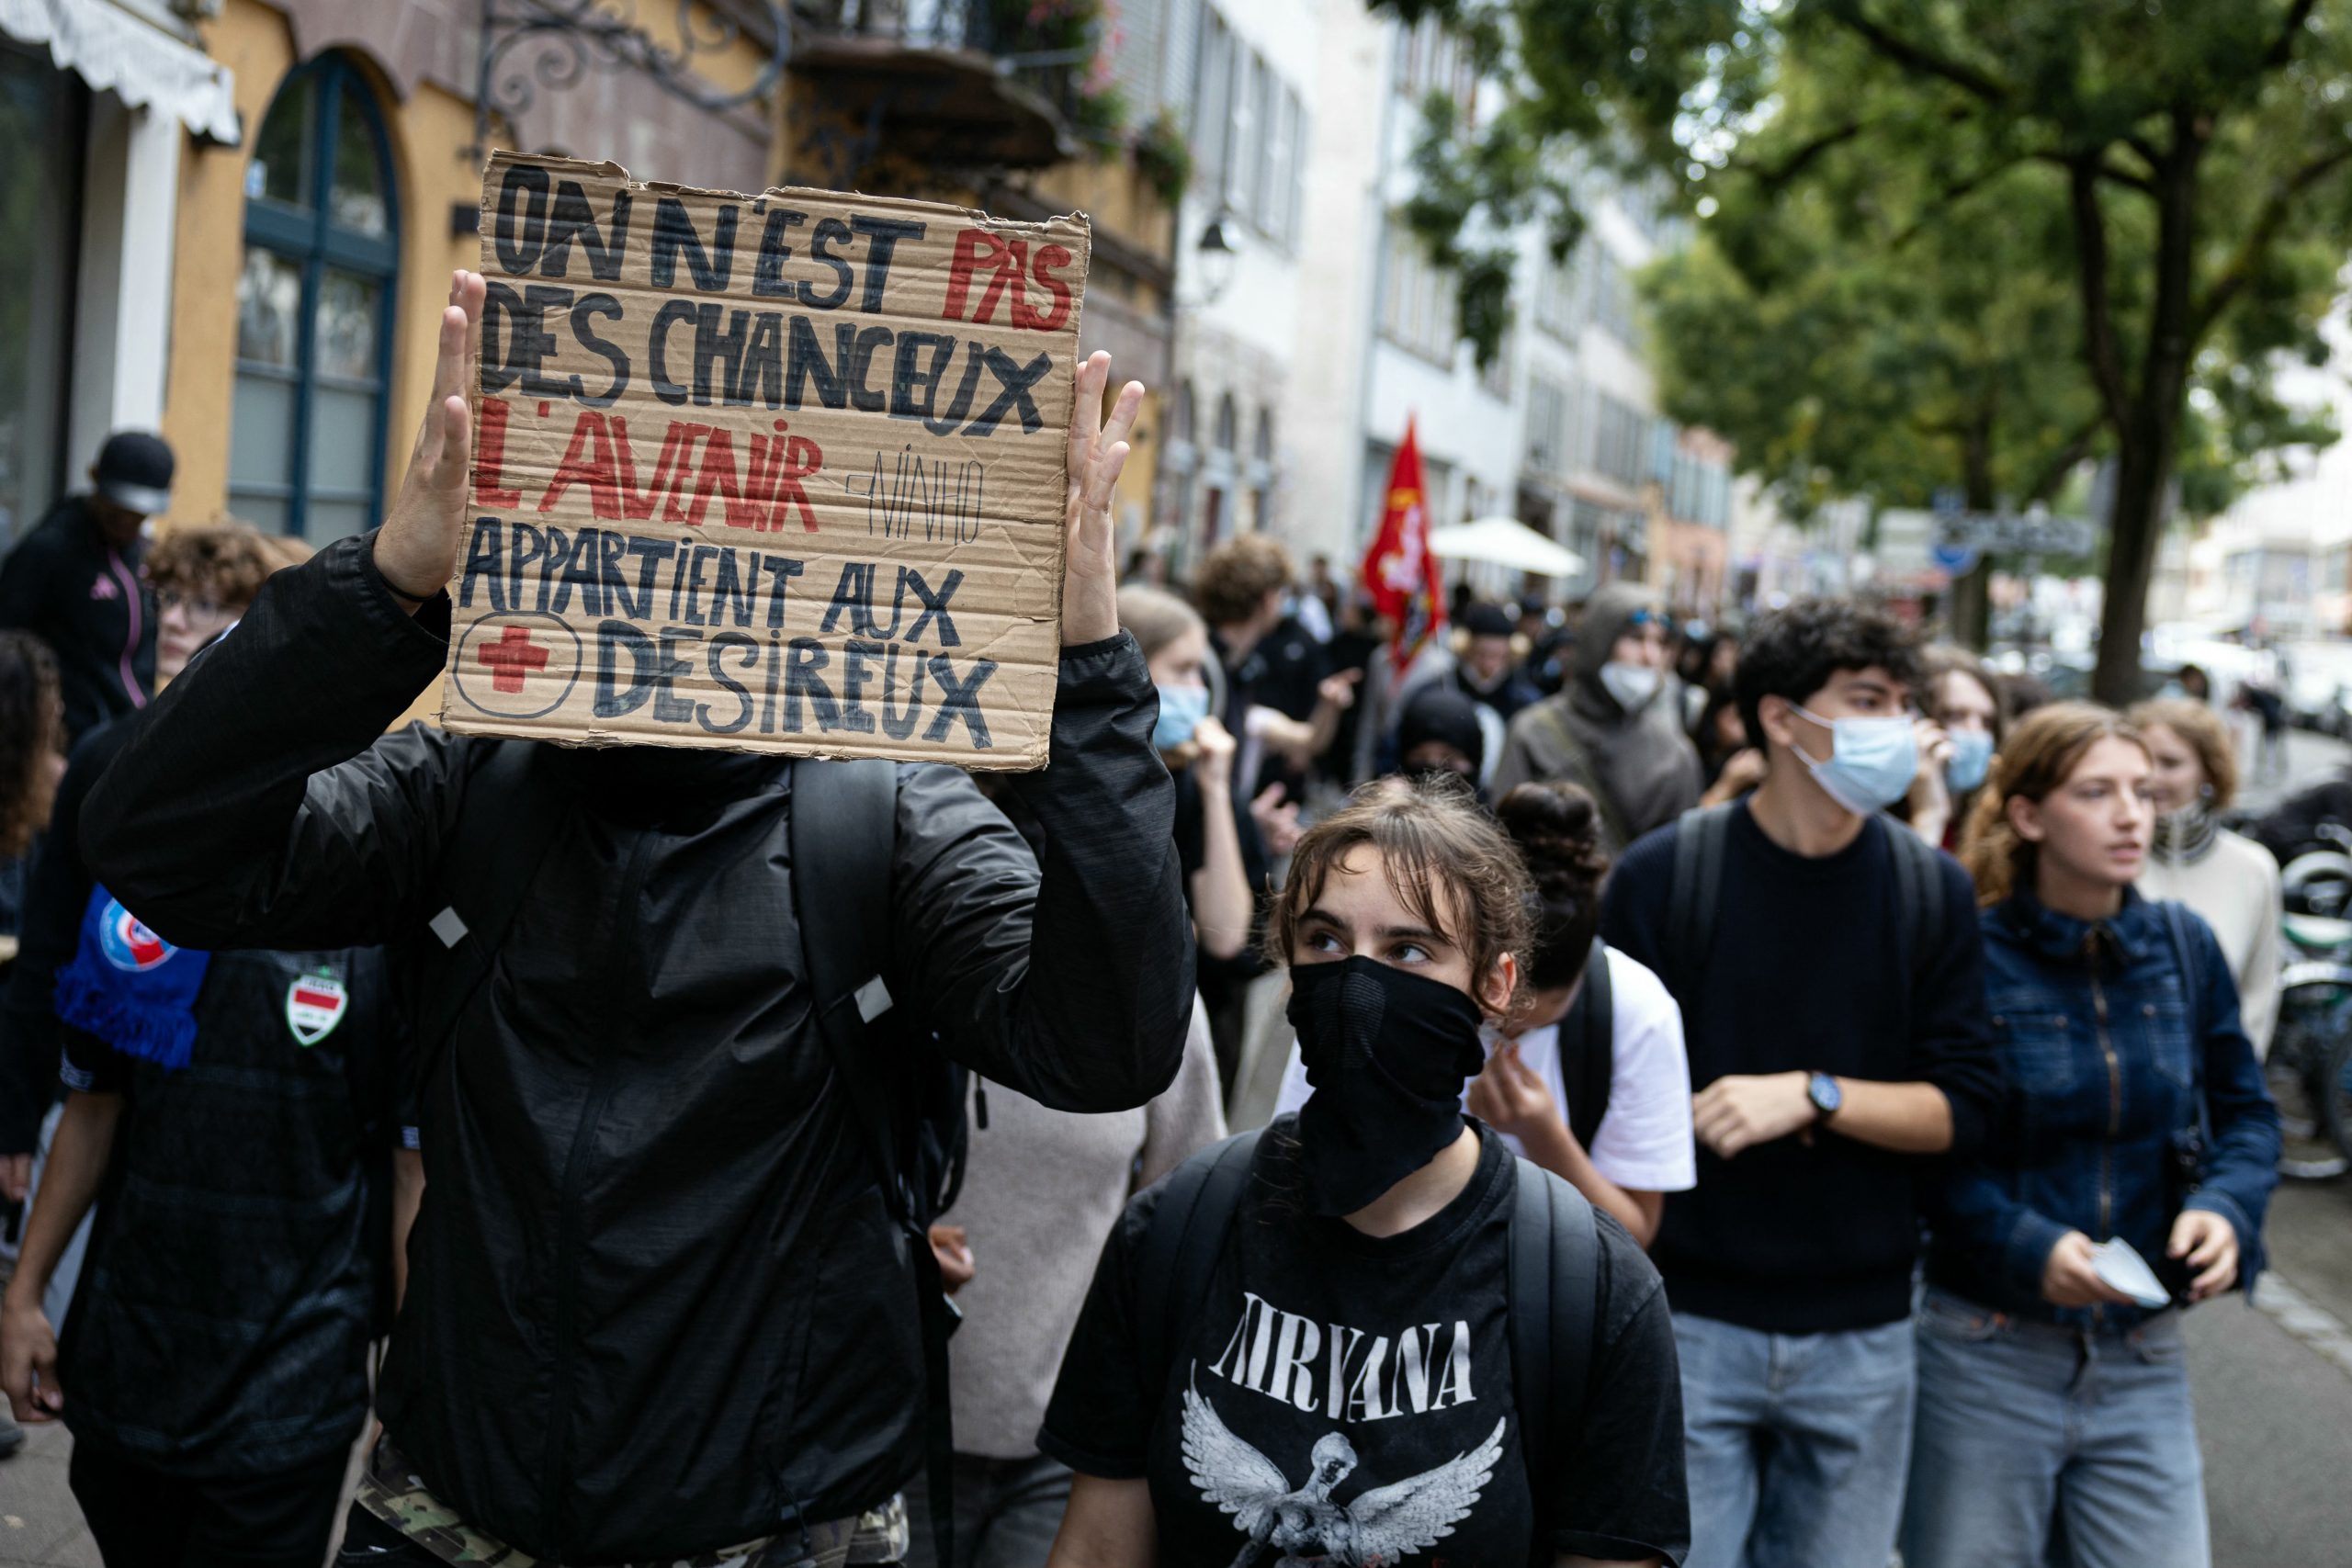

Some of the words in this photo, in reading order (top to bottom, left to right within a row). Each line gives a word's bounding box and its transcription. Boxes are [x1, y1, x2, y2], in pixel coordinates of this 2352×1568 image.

[494, 164, 633, 281] ON
[650, 197, 927, 314] N'EST
[943, 229, 1073, 332] PAS
[481, 281, 632, 408] DES
[649, 299, 1054, 436] CHANCEUX
[820, 563, 965, 647] AUX
[1208, 1292, 1477, 1423] NIRVANA
